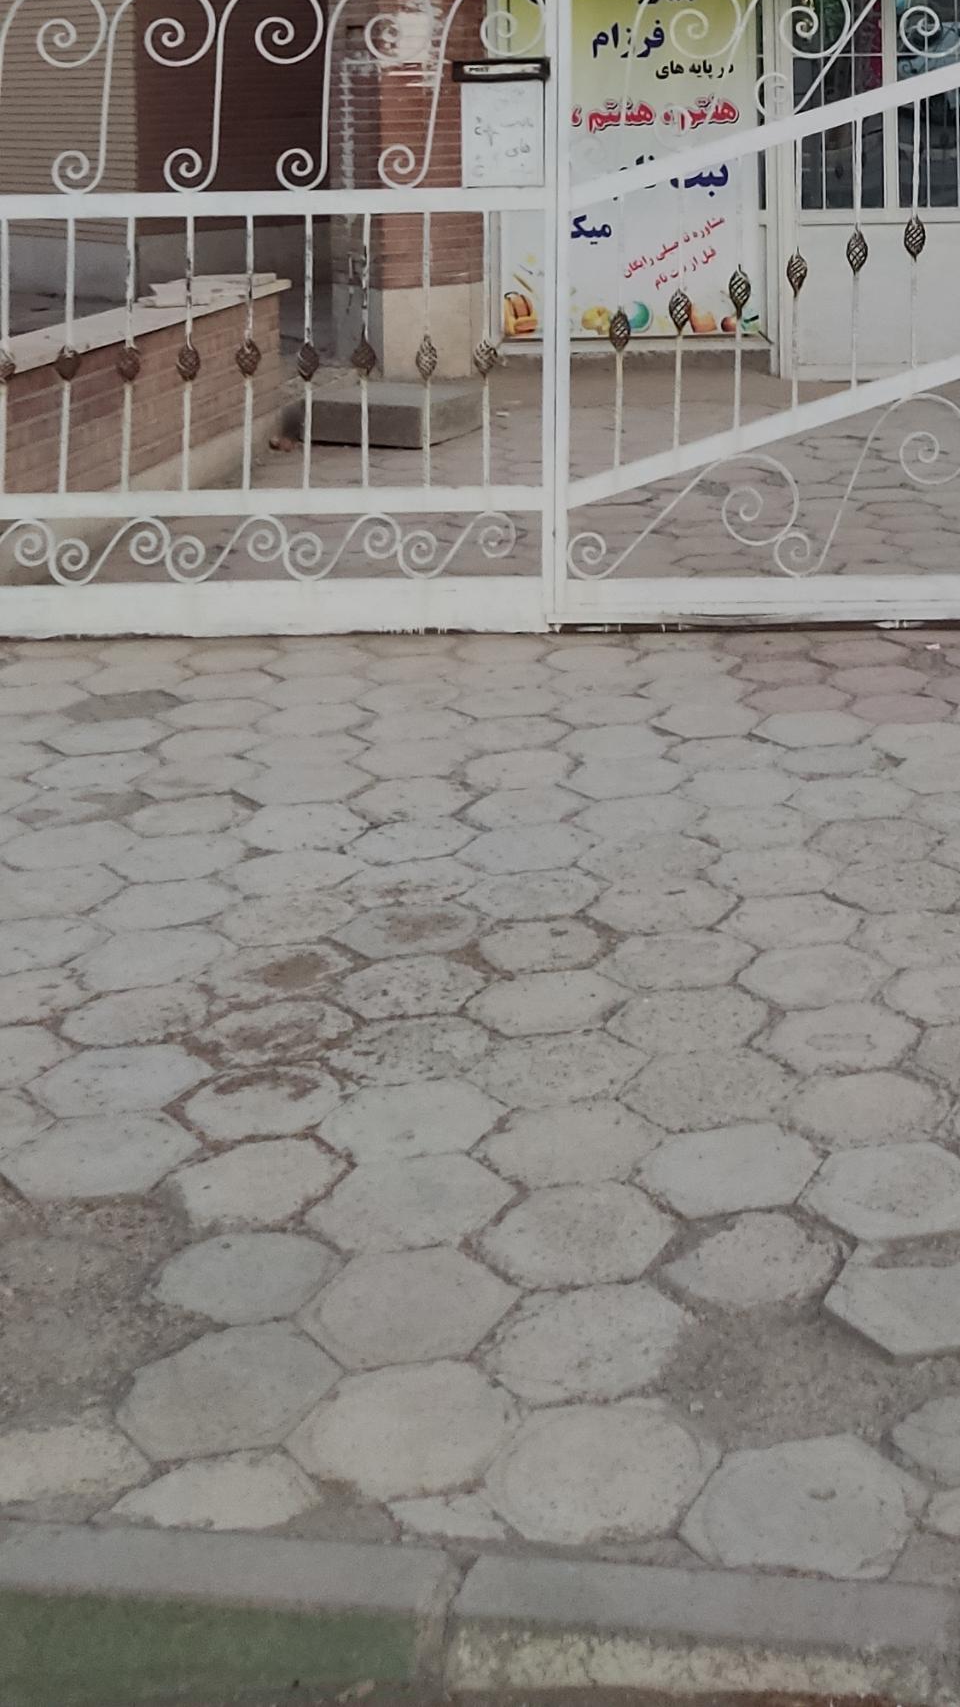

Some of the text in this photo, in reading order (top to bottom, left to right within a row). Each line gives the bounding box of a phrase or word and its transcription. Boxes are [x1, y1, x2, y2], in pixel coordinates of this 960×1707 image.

[592, 19, 665, 59] فرزام
[656, 59, 684, 80] های
[689, 59, 712, 79] پایه
[656, 234, 691, 260] تصیلی
[702, 246, 717, 264] قبل
[624, 255, 655, 279] رایگان
